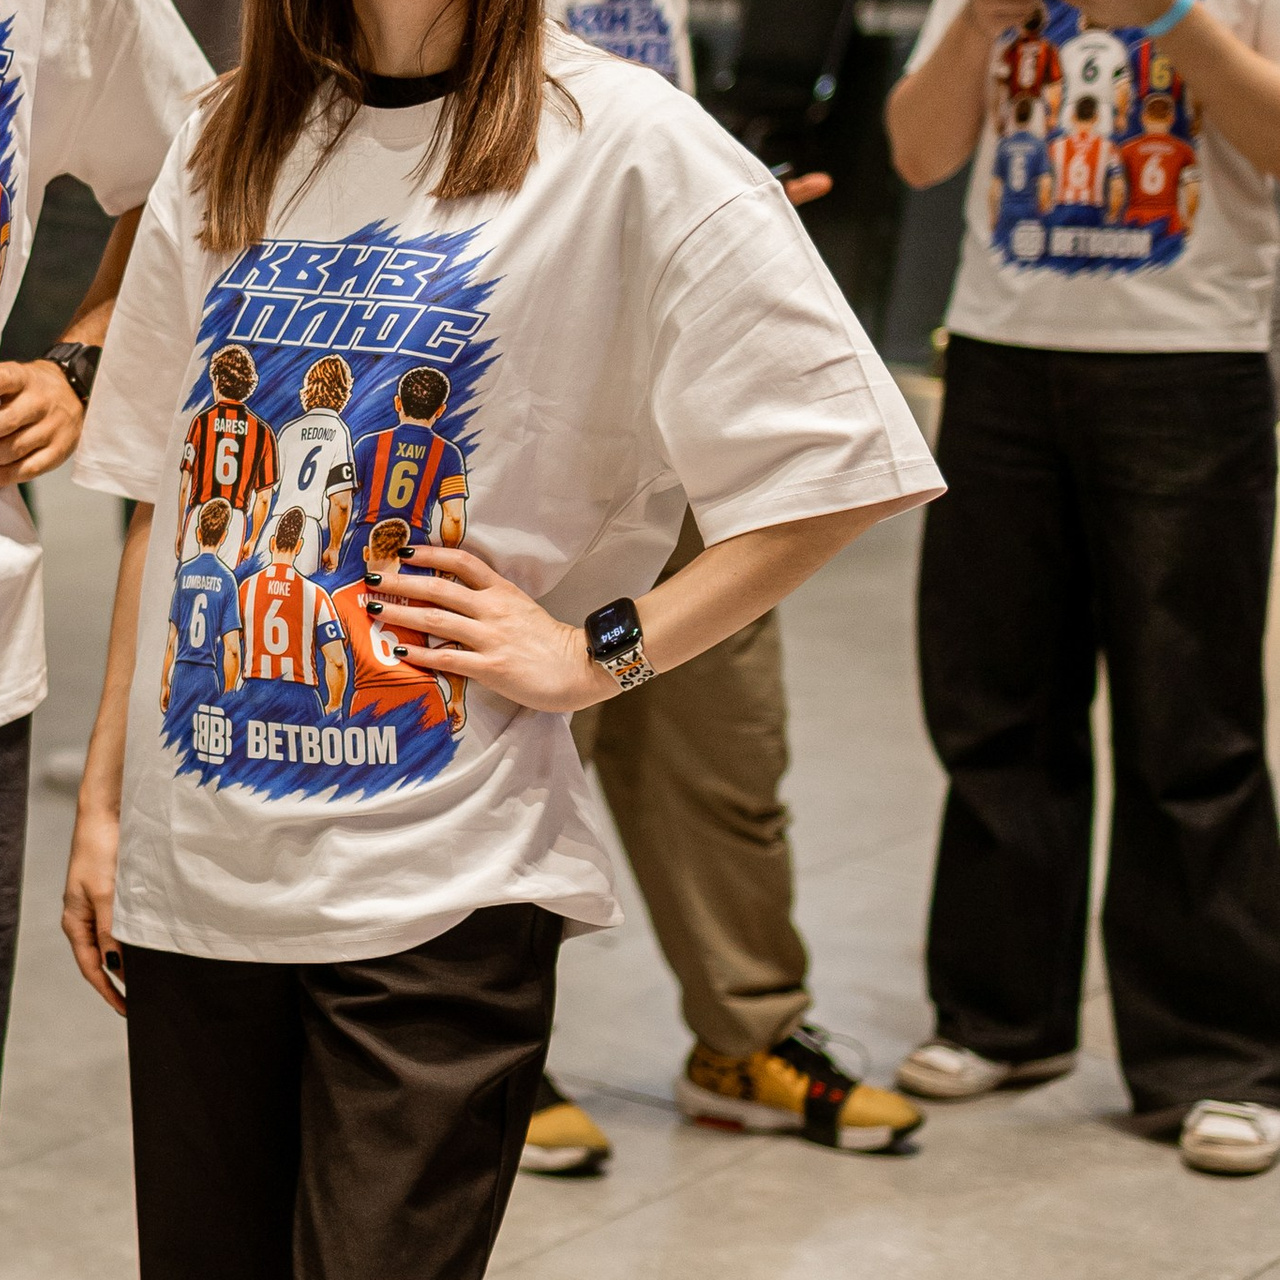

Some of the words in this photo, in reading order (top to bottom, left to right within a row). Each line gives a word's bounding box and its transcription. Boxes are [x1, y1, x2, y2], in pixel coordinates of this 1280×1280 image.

[1149, 56, 1172, 90] 6
[1139, 153, 1167, 196] 6
[218, 240, 448, 301] КВИЗ
[226, 291, 491, 364] ПЛЮС
[214, 417, 249, 436] BARESI
[300, 426, 337, 442] REDONDO
[215, 437, 240, 486] 6
[297, 445, 323, 492] 6
[342, 465, 353, 480] C
[395, 442, 427, 460] XAVI
[387, 460, 419, 509] 6
[181, 574, 223, 593] LOMBAERTS
[267, 580, 291, 597] KOKE
[190, 592, 208, 649] 6
[263, 598, 290, 655] 6
[325, 624, 337, 639] C
[369, 620, 402, 666] 6
[247, 720, 398, 766] BETBOOM
